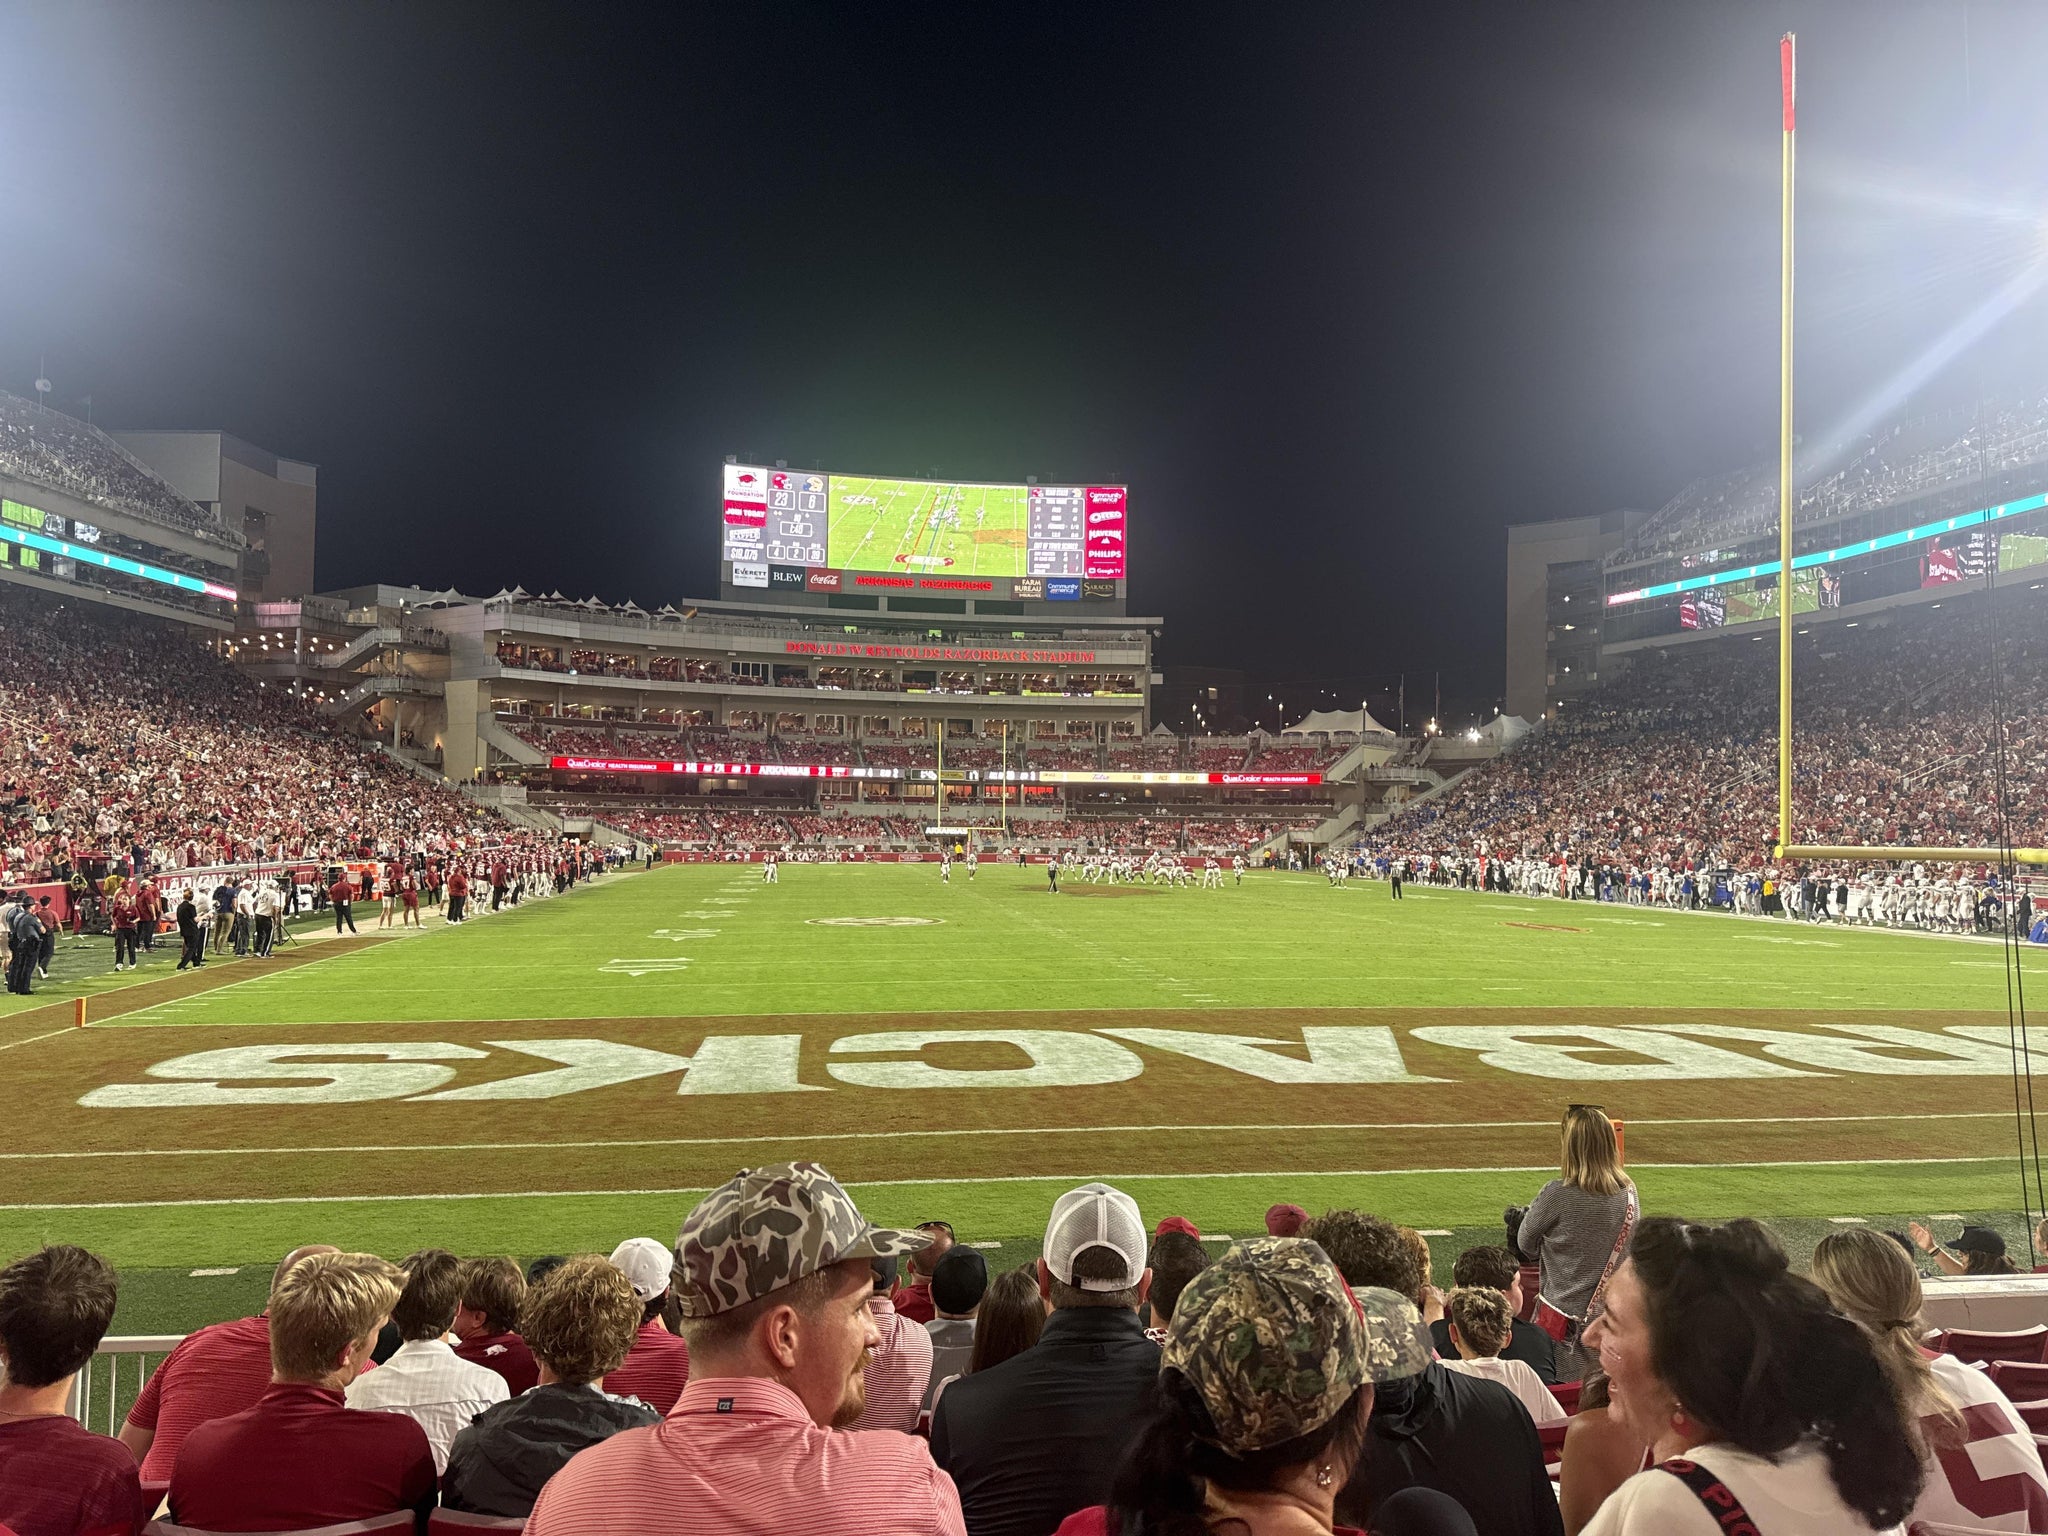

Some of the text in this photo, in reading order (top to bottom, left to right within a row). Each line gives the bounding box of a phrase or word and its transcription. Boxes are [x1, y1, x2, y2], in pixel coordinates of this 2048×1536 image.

[774, 492, 788, 506] 23
[773, 572, 803, 582] BLEW
[855, 576, 993, 591] ARKANSAS RAZORBACKS
[786, 641, 1095, 663] DONALD W REYNOLDS RAZORBACK STADIUM
[758, 765, 810, 776] ARKANSAS
[925, 826, 968, 835] ARKANSAS
[1614, 1203, 1634, 1253] GO HOGS
[1603, 1261, 1613, 1278] GO
